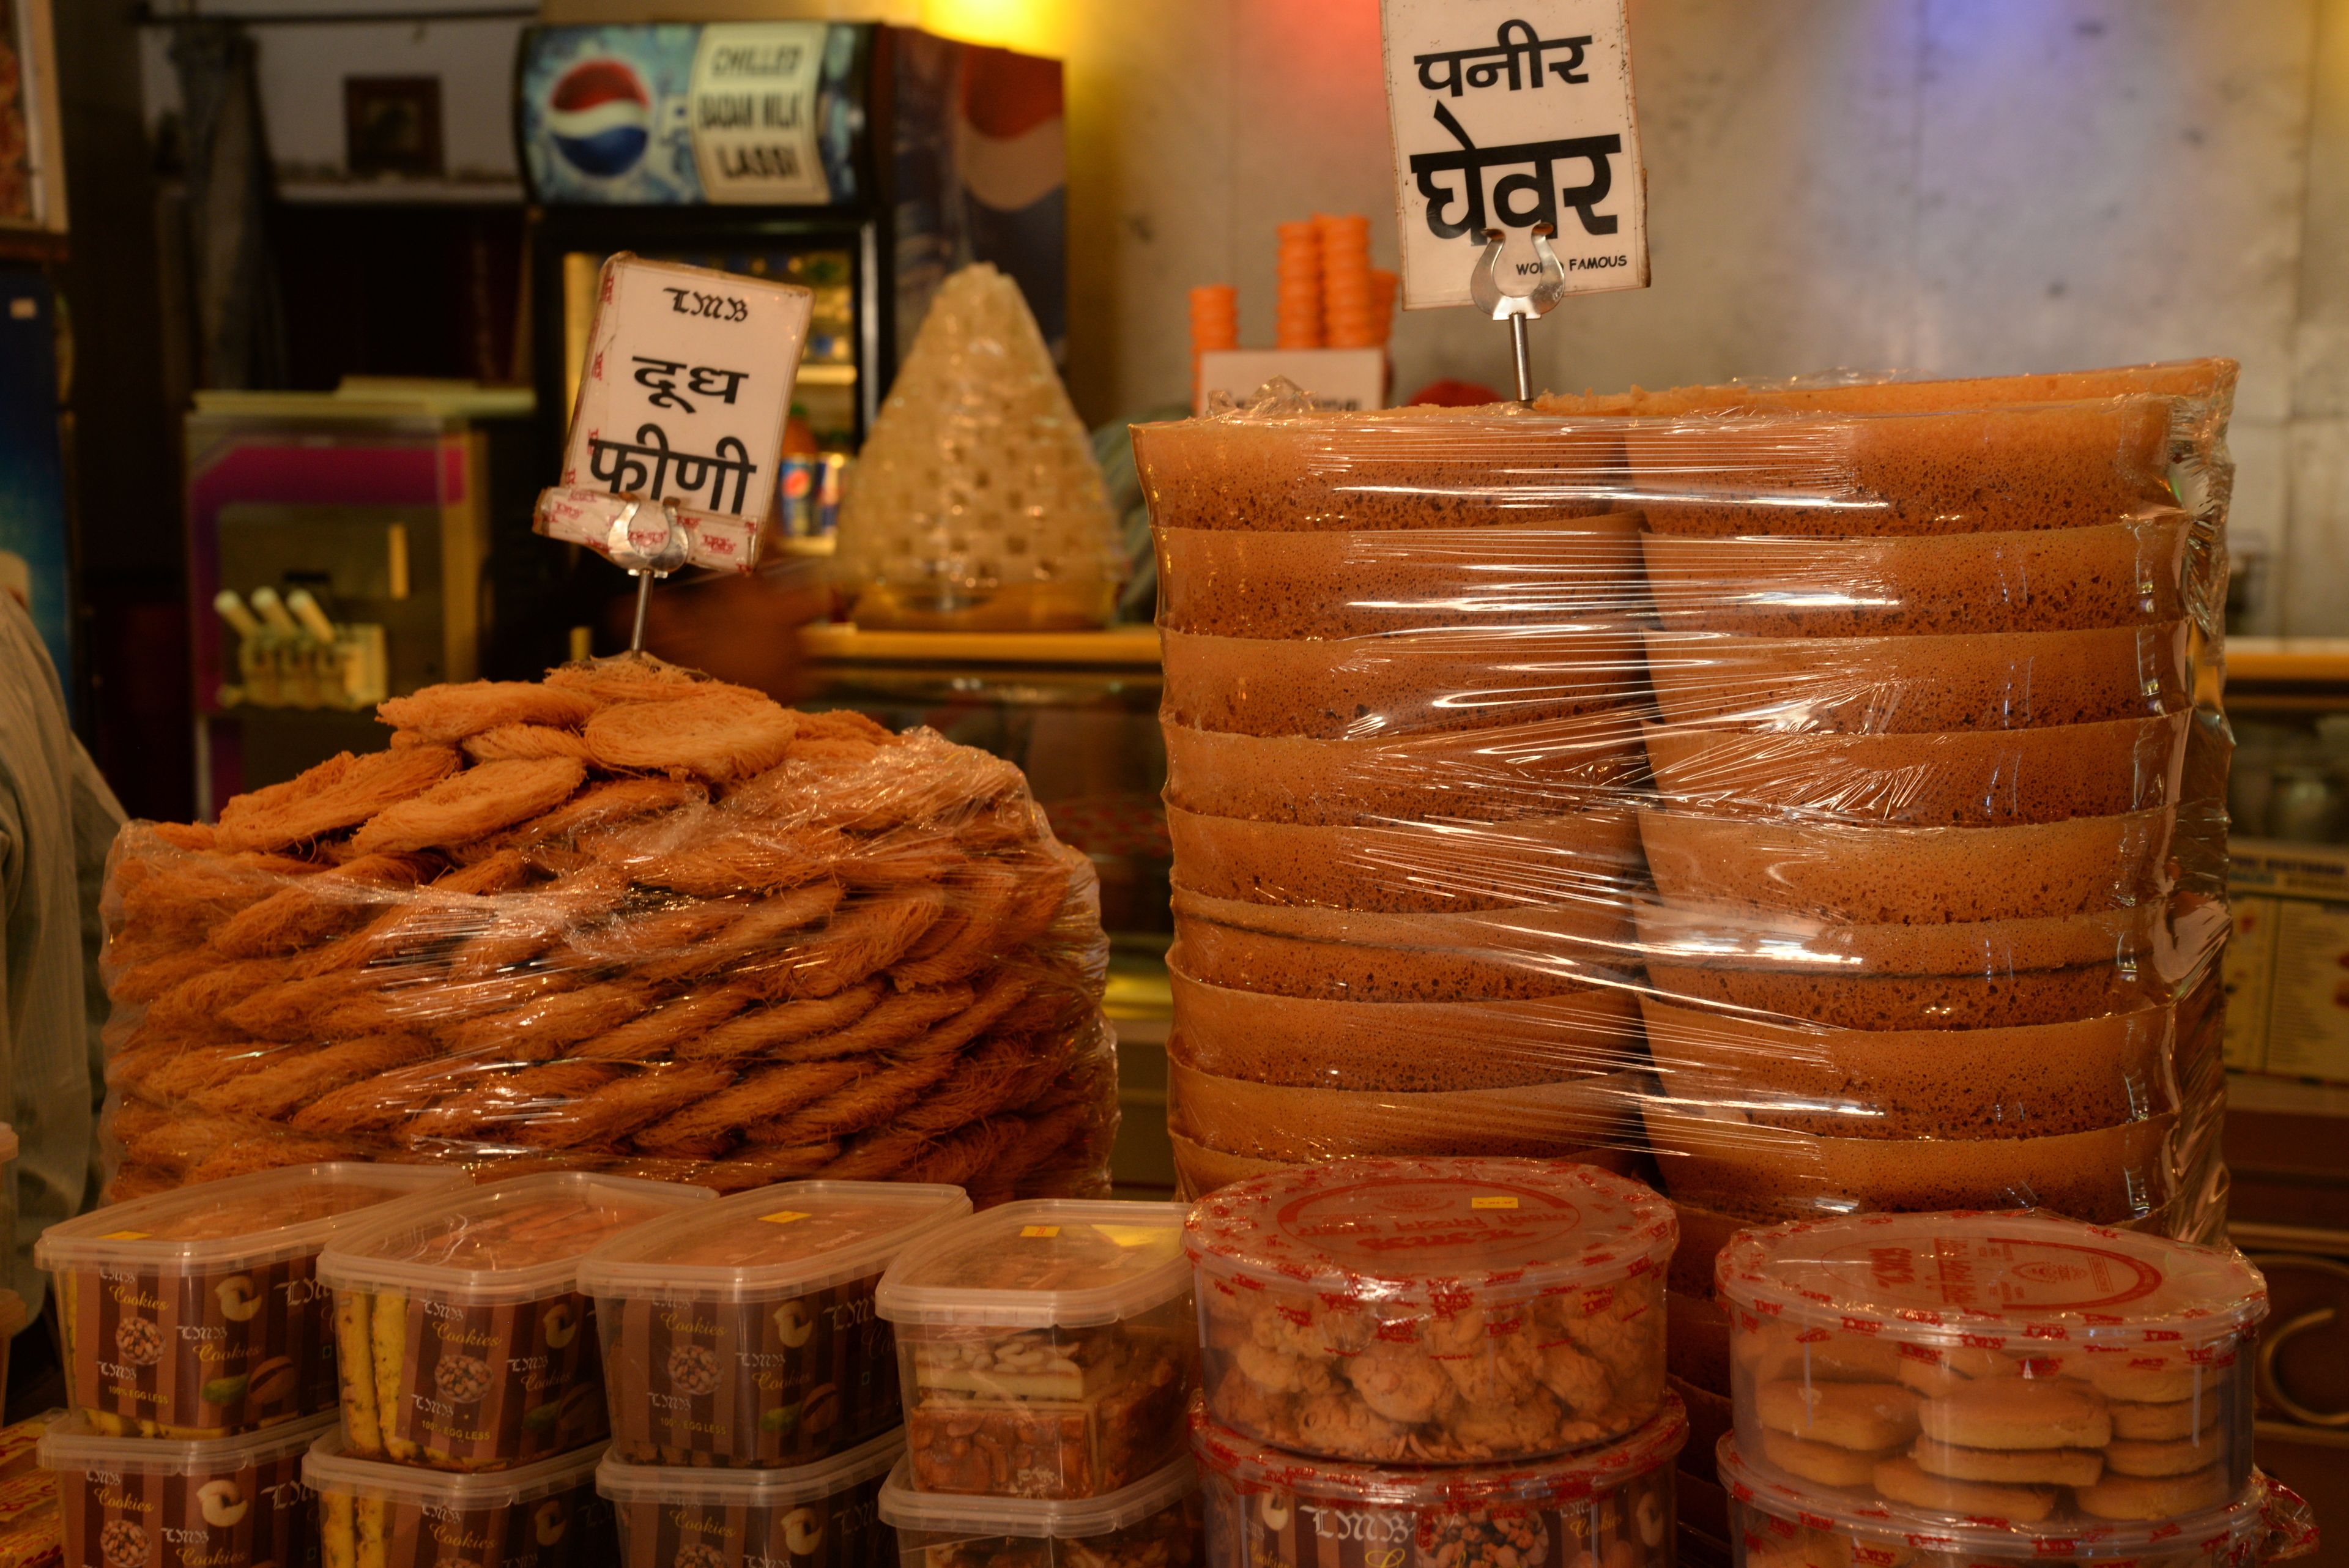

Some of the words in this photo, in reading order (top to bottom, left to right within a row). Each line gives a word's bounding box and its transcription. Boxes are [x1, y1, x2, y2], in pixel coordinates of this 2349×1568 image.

[1414, 19, 1592, 97] पनीर
[1409, 100, 1622, 246] घेवर
[1569, 255, 1627, 271] FAMOUS
[632, 356, 749, 414] दूध
[588, 423, 757, 515] फीणी
[109, 1285, 169, 1312] Cookies
[432, 1321, 501, 1347] Cookies
[660, 1312, 727, 1337] Cookies
[193, 1344, 263, 1362] Cookies
[149, 1392, 169, 1405] LESS
[465, 1429, 491, 1441] LESS
[705, 1422, 727, 1435] LESS
[94, 1488, 154, 1513] Cookies
[429, 1523, 499, 1548] Cookies
[669, 1509, 737, 1539] Cookies
[176, 1548, 247, 1567] Cookies
